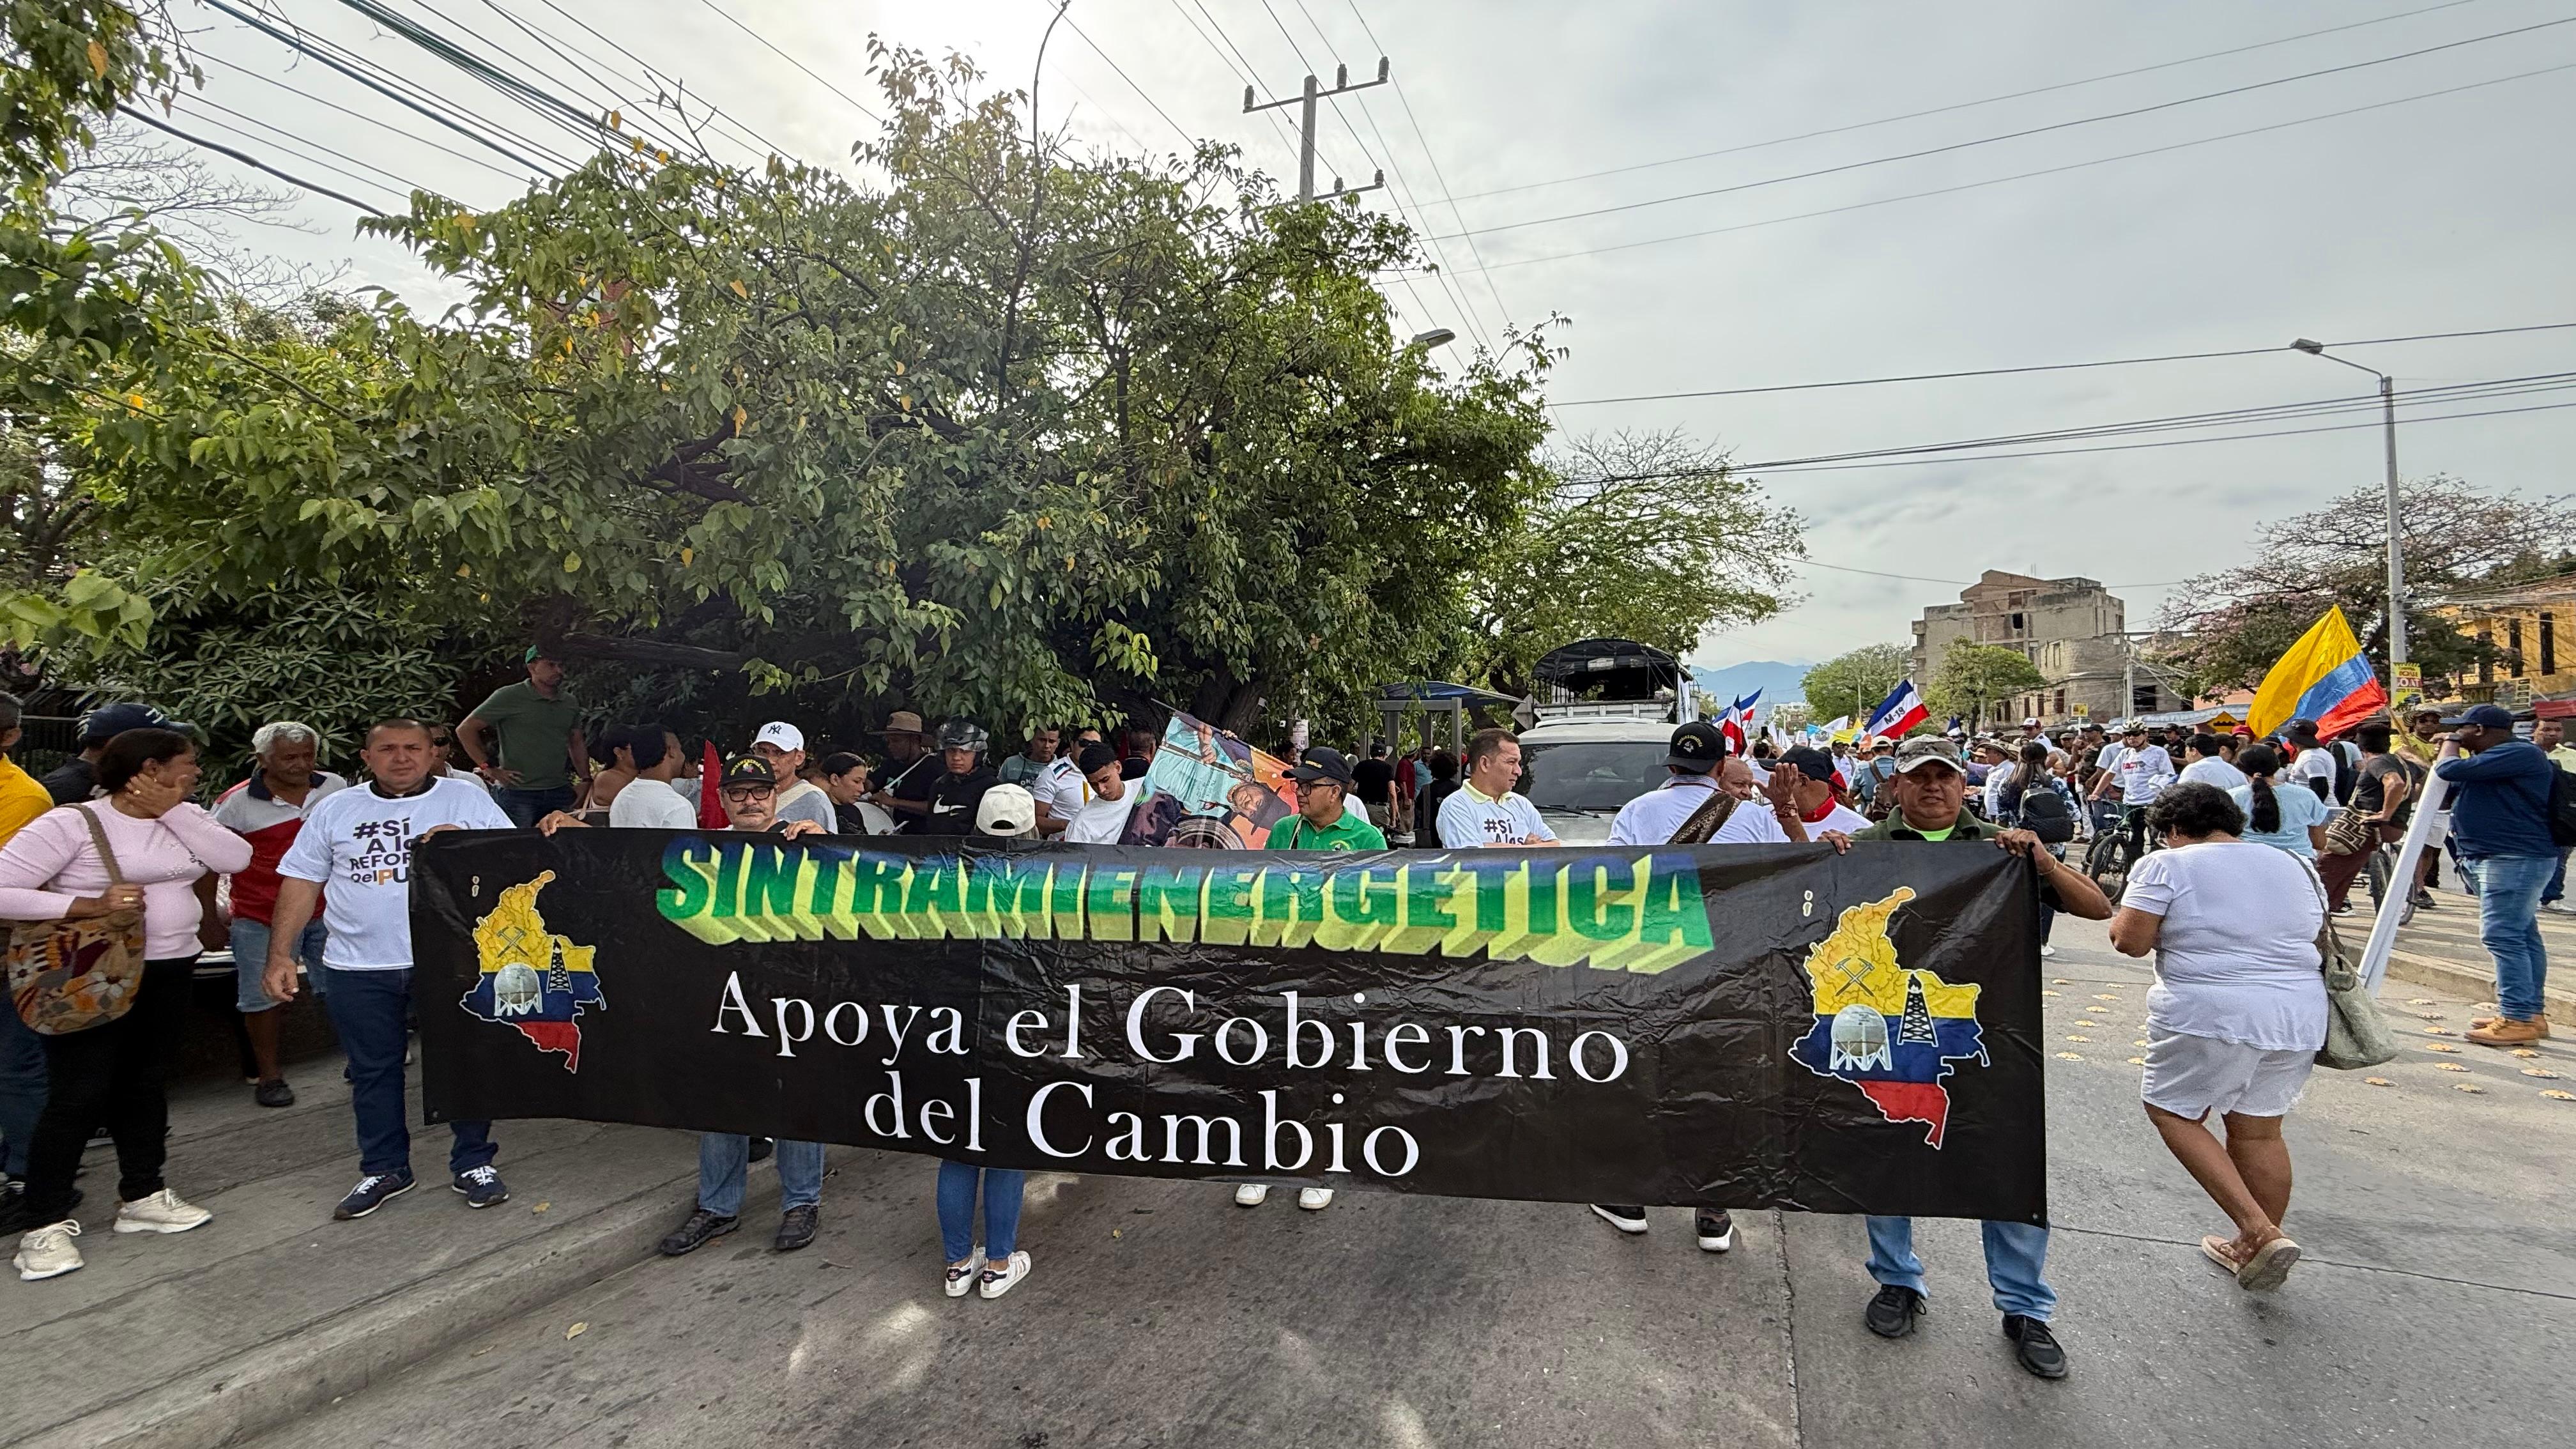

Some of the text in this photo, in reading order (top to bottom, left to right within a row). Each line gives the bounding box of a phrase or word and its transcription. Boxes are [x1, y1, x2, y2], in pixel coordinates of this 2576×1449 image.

[2398, 678, 2420, 687] OAT
[767, 724, 782, 735] NY
[1883, 707, 1906, 725] M-19
[656, 836, 1715, 974] SINTRAMIENERGÉTICA
[710, 970, 1629, 1084] Apoya el Gobierno
[864, 1070, 1420, 1177] del Cambio
